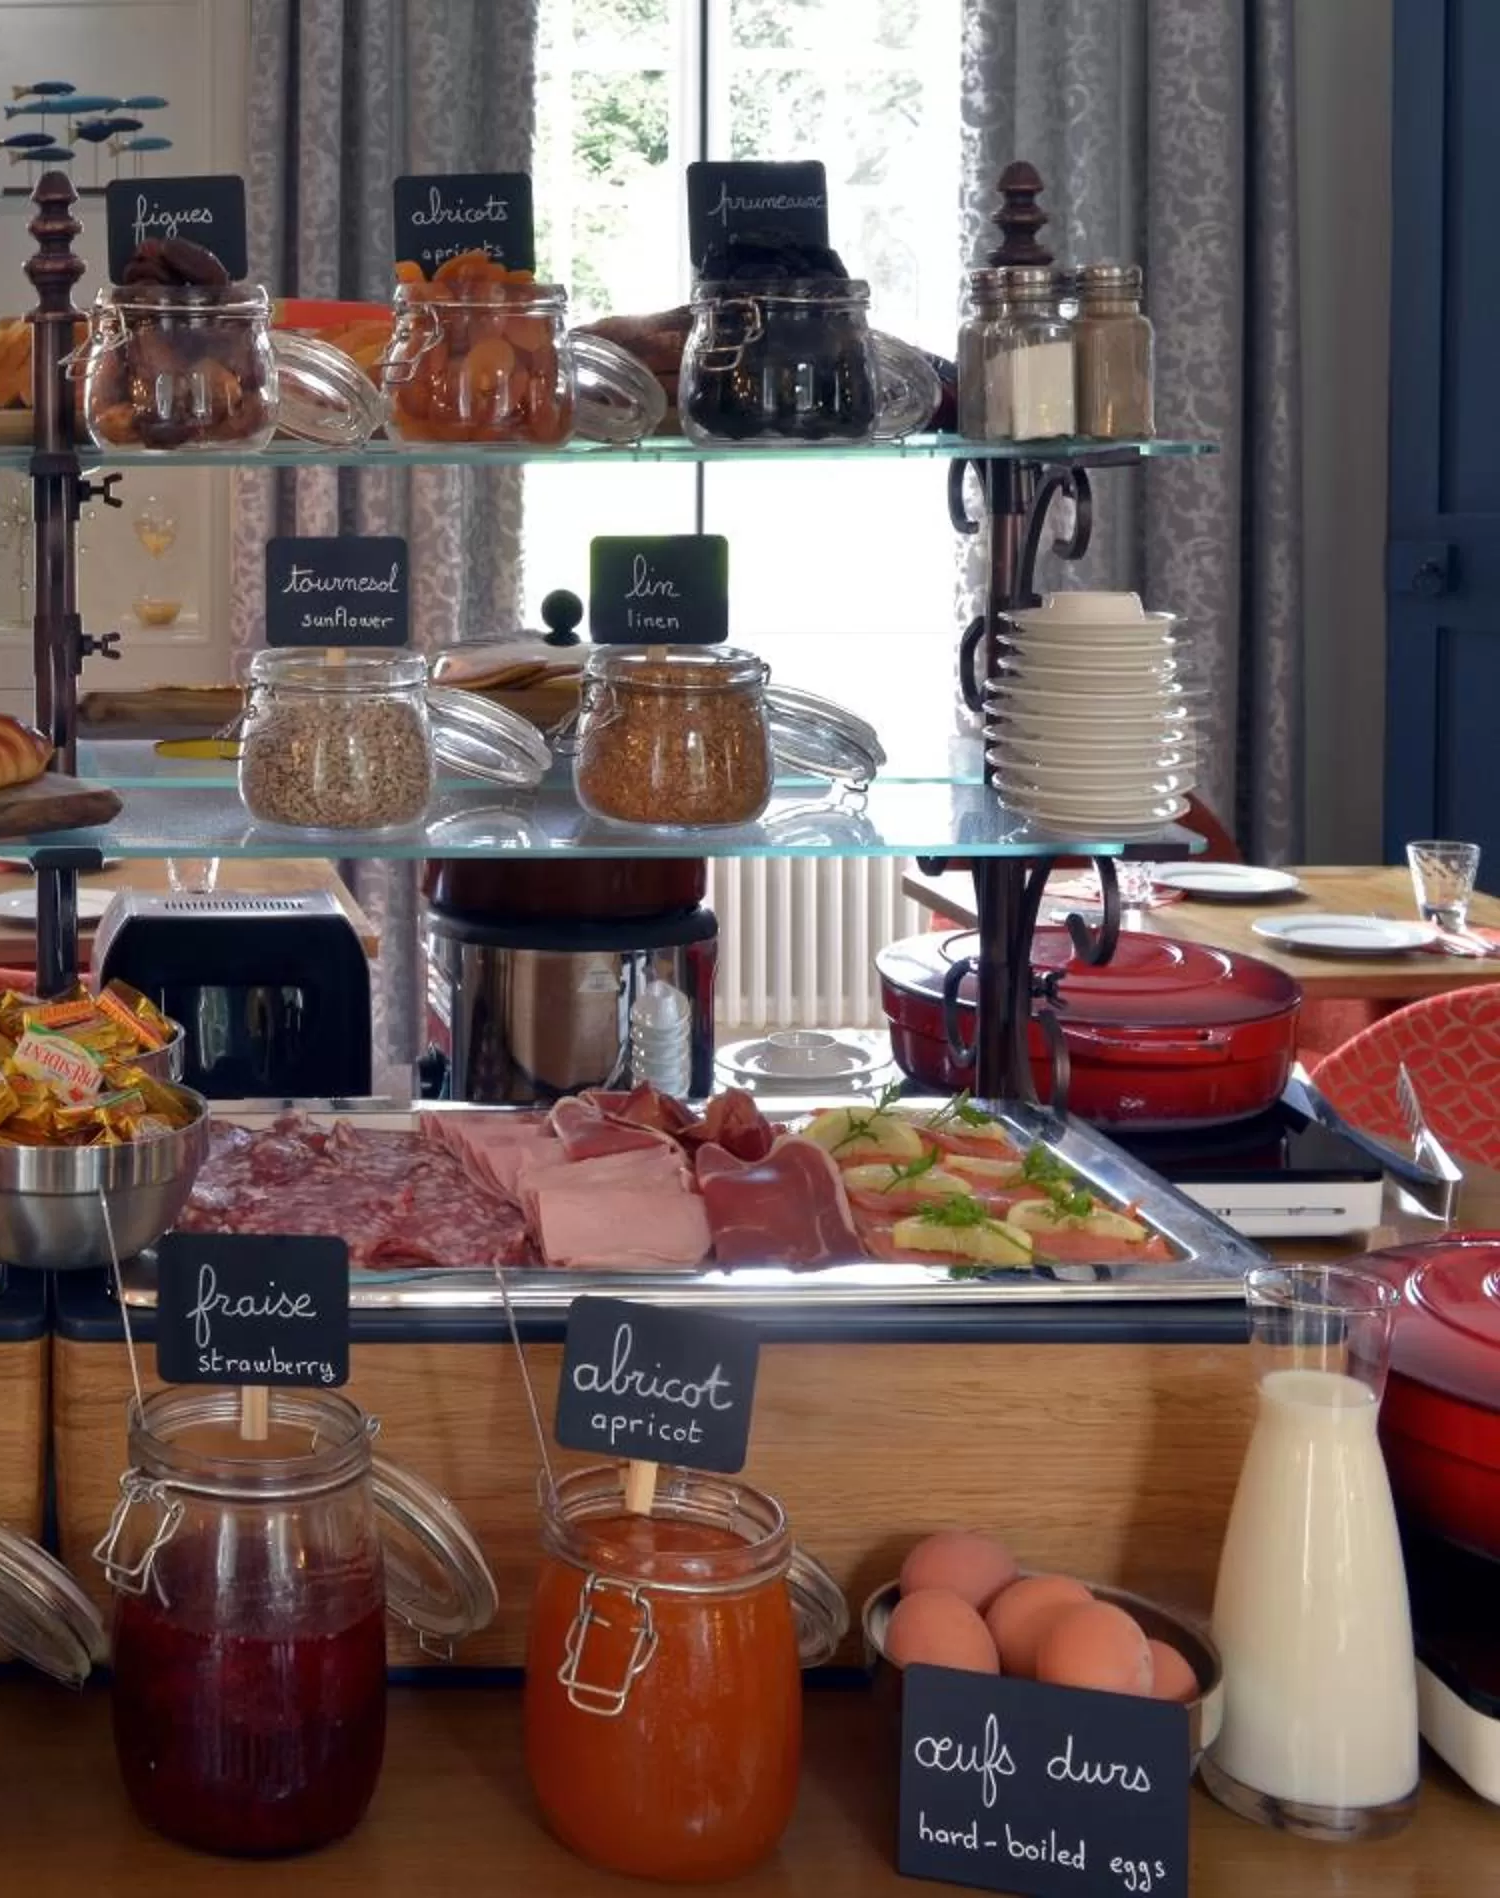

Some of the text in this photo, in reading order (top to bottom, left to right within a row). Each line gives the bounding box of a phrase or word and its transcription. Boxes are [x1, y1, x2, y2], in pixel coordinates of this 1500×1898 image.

[131, 193, 213, 248] figues
[411, 186, 509, 225] abricots
[421, 239, 505, 265] aprits
[282, 561, 399, 594] tournesol
[625, 553, 682, 599] lin
[301, 606, 395, 629] sunflower
[627, 608, 681, 630] linen
[185, 1263, 317, 1348] fraise
[198, 1346, 337, 1383] strawberry
[572, 1322, 733, 1410] abricot
[591, 1412, 704, 1446] apricot
[1046, 1734, 1151, 1793] durs
[1109, 1856, 1166, 1893] eggs
